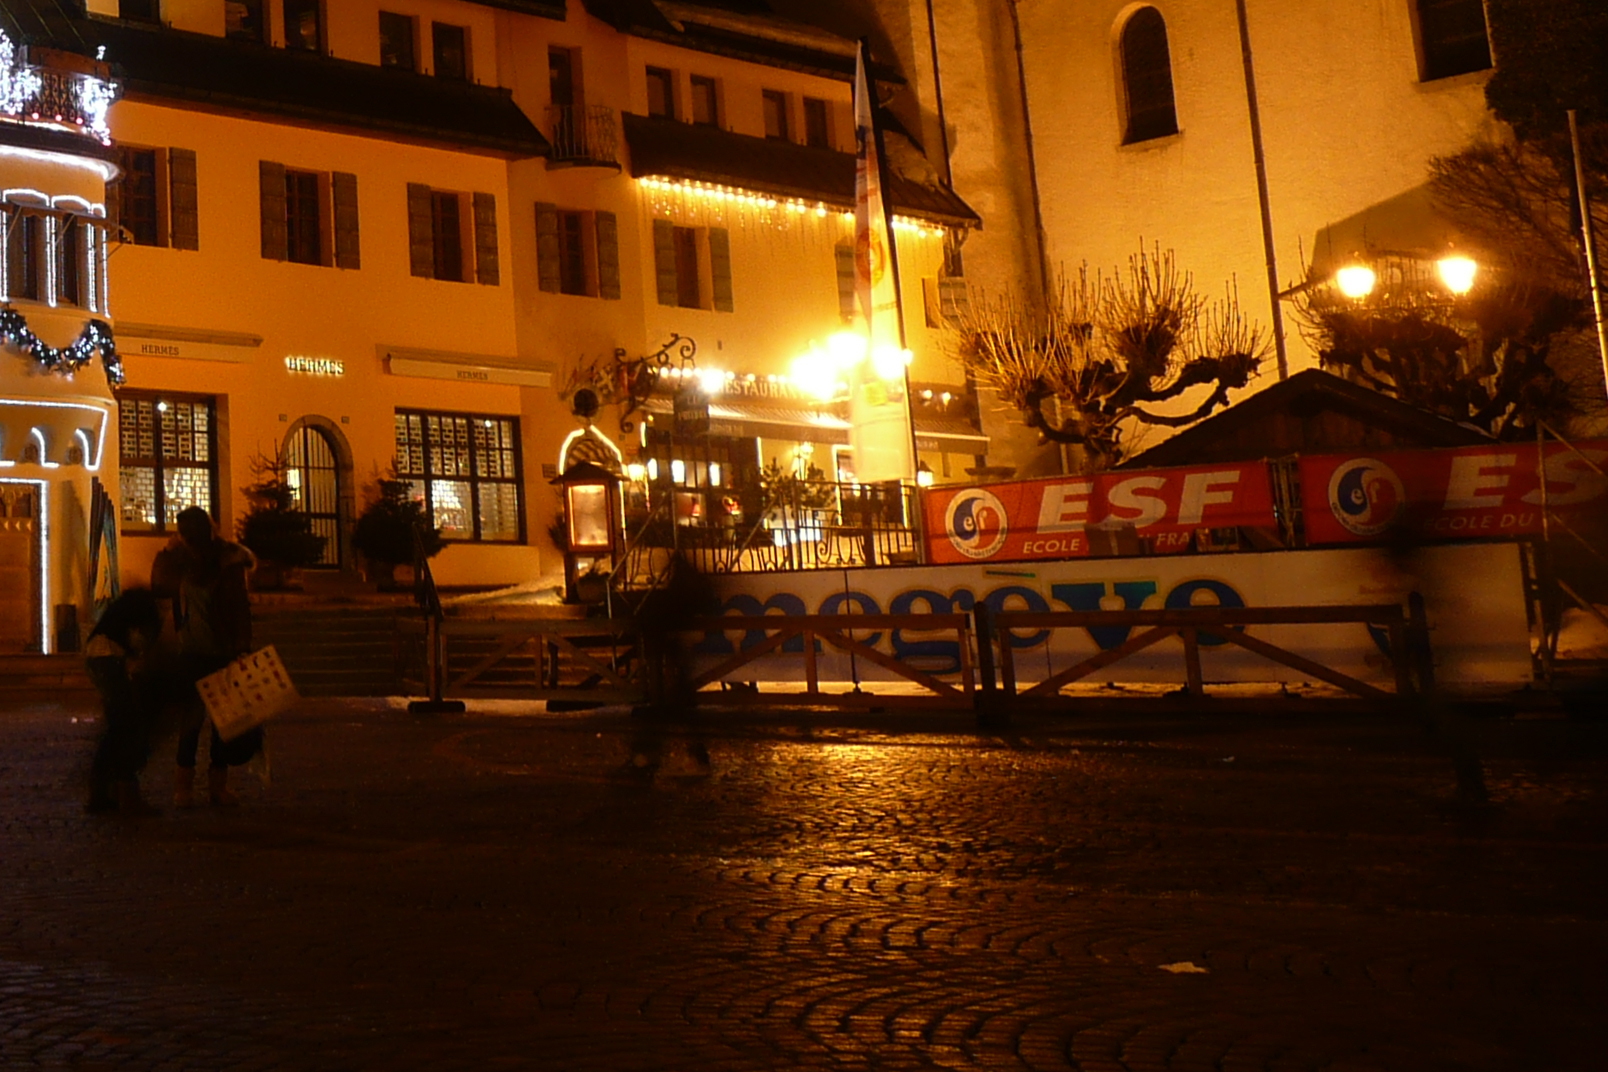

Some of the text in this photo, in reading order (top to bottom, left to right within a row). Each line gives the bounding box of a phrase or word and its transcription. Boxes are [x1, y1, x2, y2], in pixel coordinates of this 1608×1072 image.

[1035, 469, 1241, 535] ESF
[1423, 514, 1495, 530] ECOLE
[1500, 512, 1534, 528] DU
[1023, 538, 1081, 554] ECOLE
